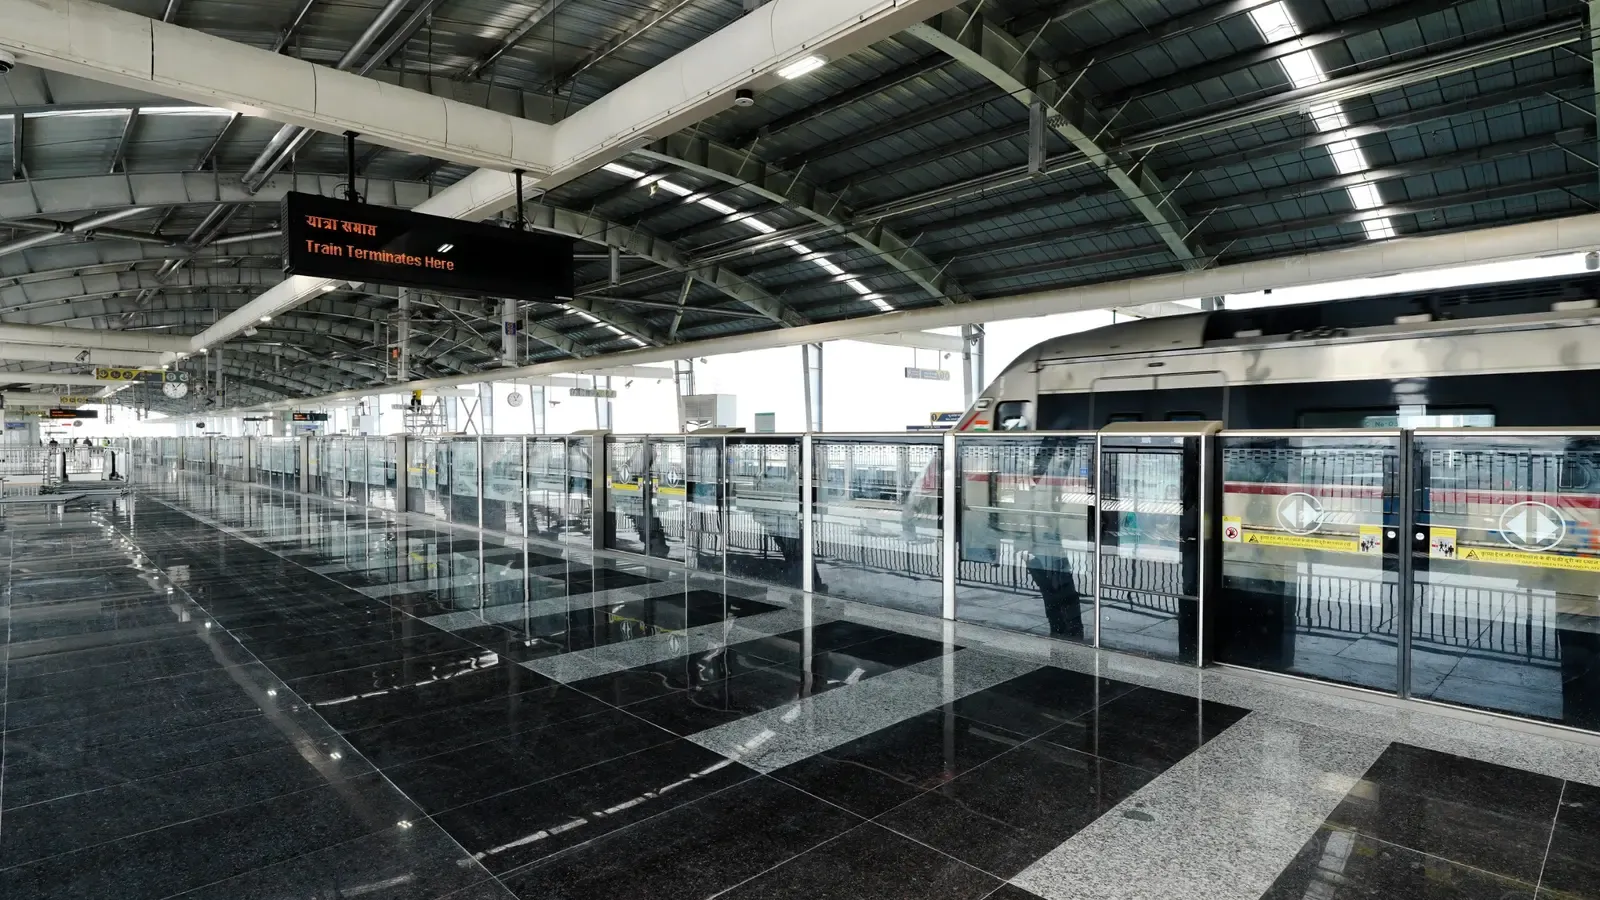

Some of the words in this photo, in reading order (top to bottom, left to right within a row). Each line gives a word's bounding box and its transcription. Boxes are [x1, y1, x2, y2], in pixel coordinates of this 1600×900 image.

[305, 215, 339, 230] यात्रा
[305, 239, 342, 256] Train
[347, 245, 422, 267] Terminates
[425, 256, 454, 270] Here
